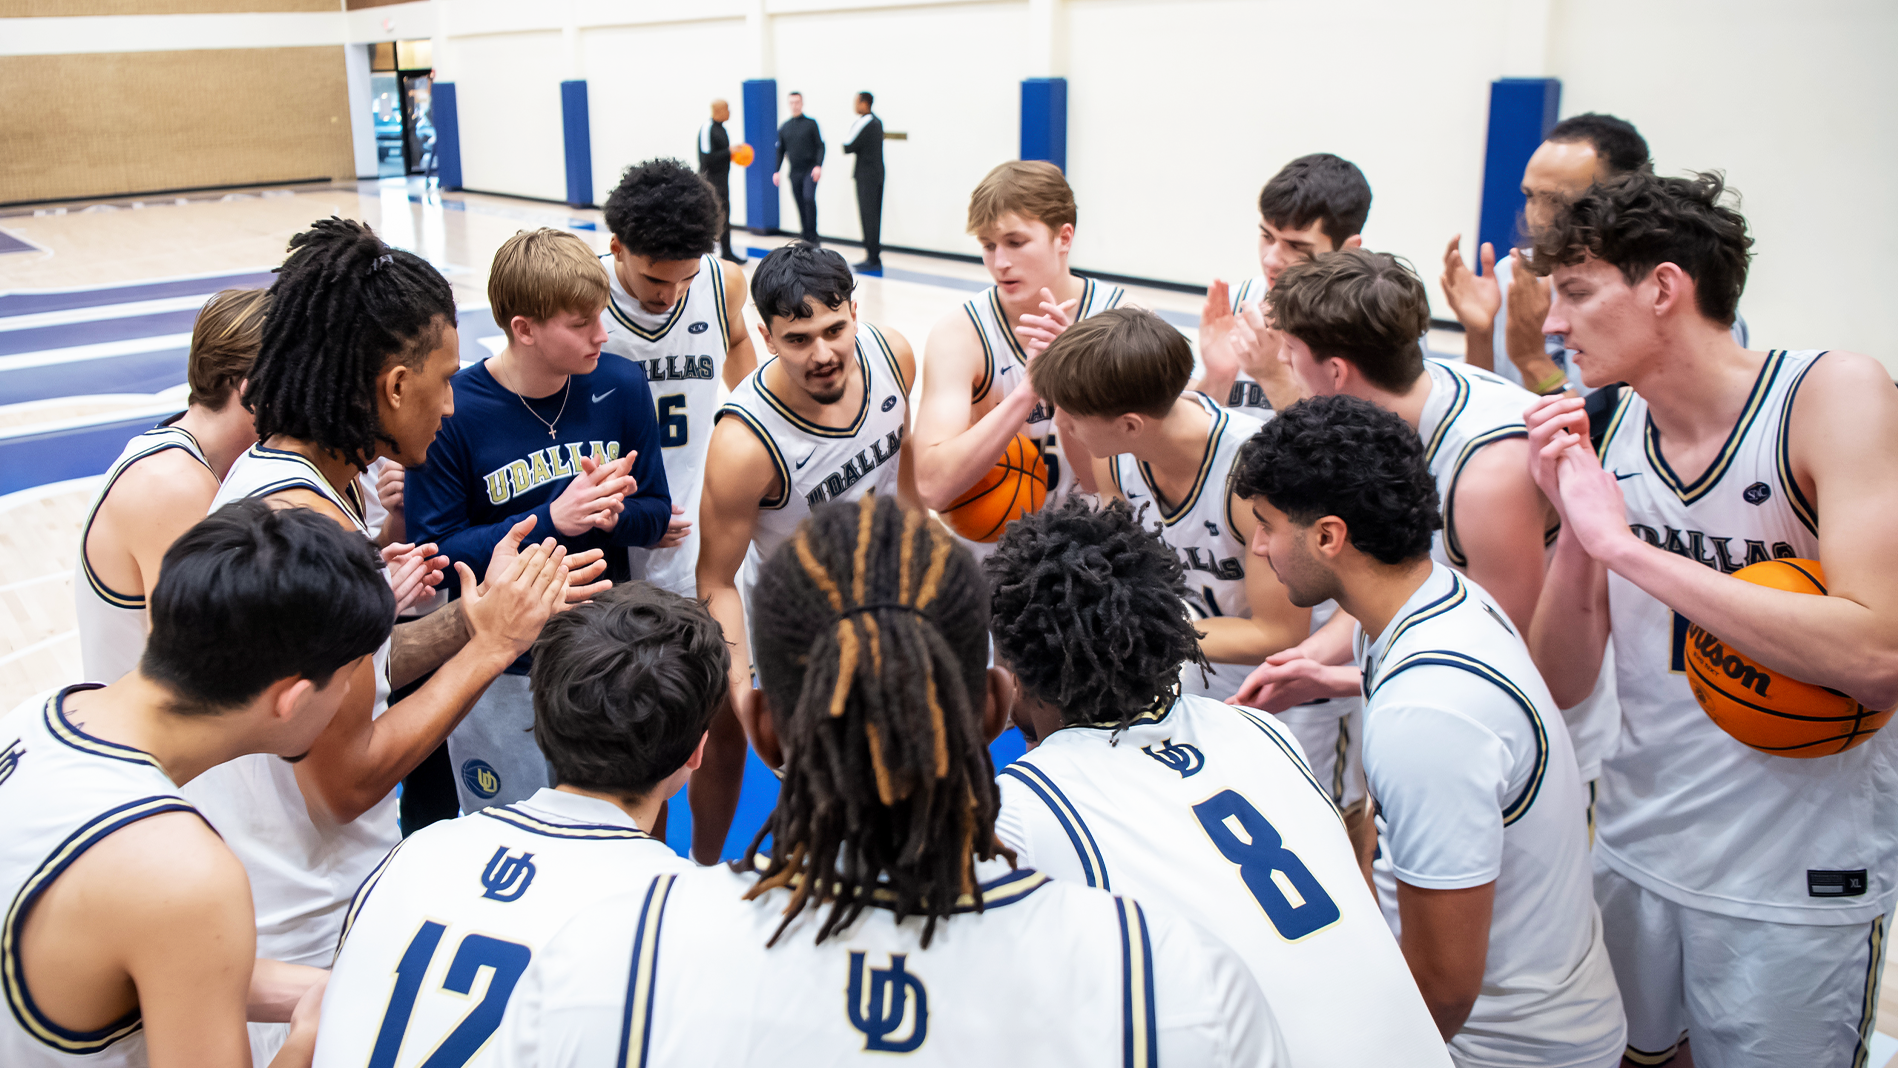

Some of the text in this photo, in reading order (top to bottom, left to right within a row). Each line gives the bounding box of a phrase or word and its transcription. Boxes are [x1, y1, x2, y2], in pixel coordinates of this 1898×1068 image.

[1191, 787, 1343, 943] 8
[1850, 878, 1862, 888] XL
[365, 916, 533, 1068] 12
